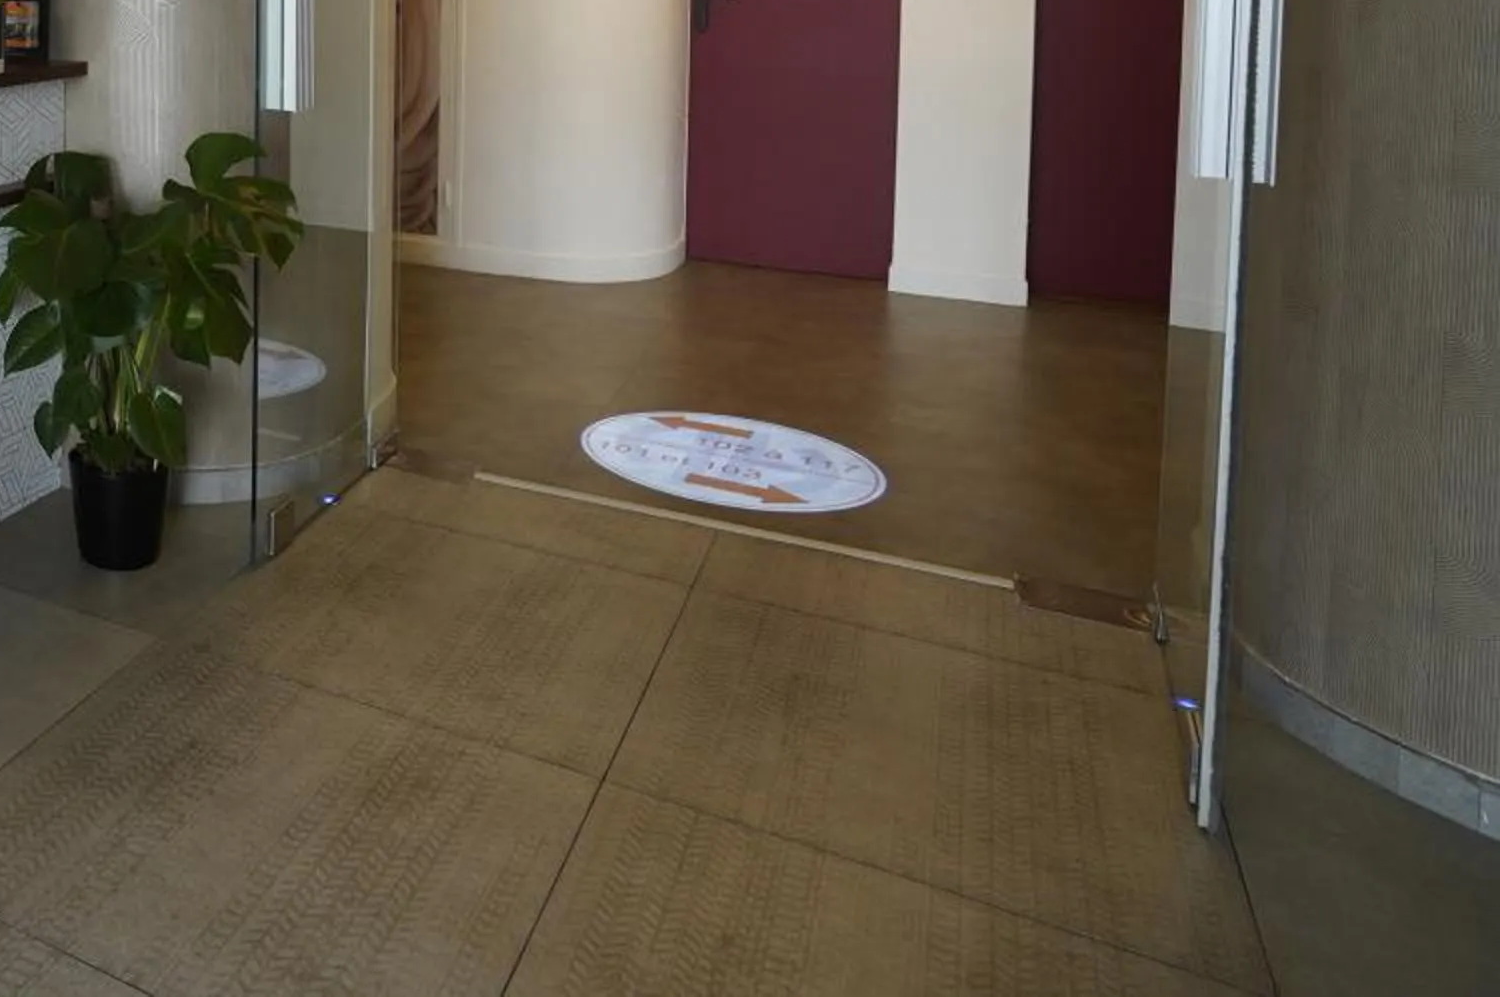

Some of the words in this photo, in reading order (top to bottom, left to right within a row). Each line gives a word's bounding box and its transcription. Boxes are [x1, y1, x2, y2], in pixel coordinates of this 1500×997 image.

[601, 439, 649, 459] 101
[707, 461, 763, 480] 103
[699, 435, 755, 455] 102
